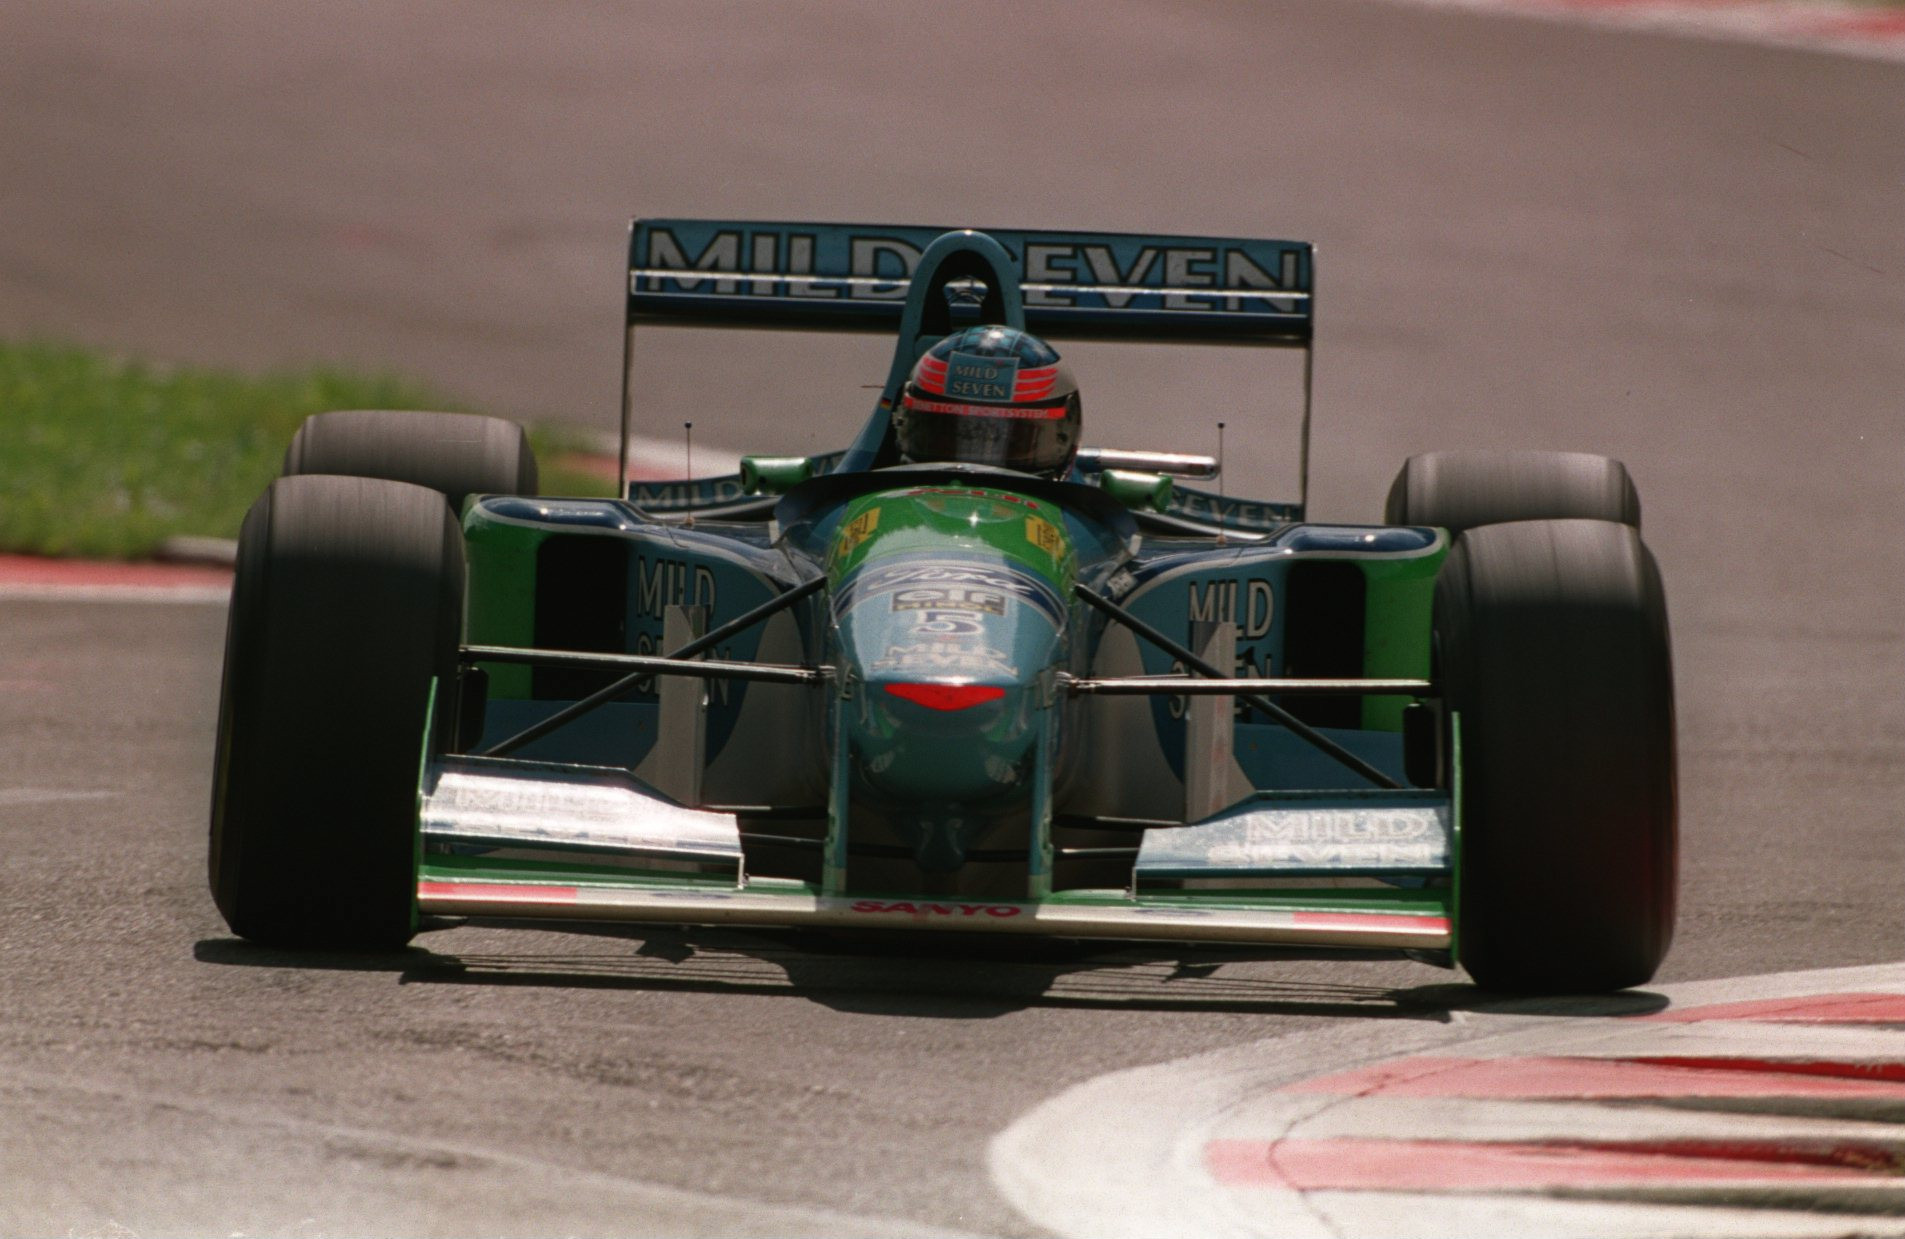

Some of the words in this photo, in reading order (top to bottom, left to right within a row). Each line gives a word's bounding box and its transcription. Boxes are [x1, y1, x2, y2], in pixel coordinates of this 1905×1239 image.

[648, 229, 924, 300] MILD
[1019, 244, 1299, 313] EVEN
[954, 364, 999, 380] MILD
[951, 380, 1006, 398] SEVEN
[637, 480, 743, 507] MILD
[637, 556, 715, 620] MILD
[912, 611, 985, 635] 5
[1247, 811, 1428, 842] MILD
[851, 901, 1021, 917] SANYO
